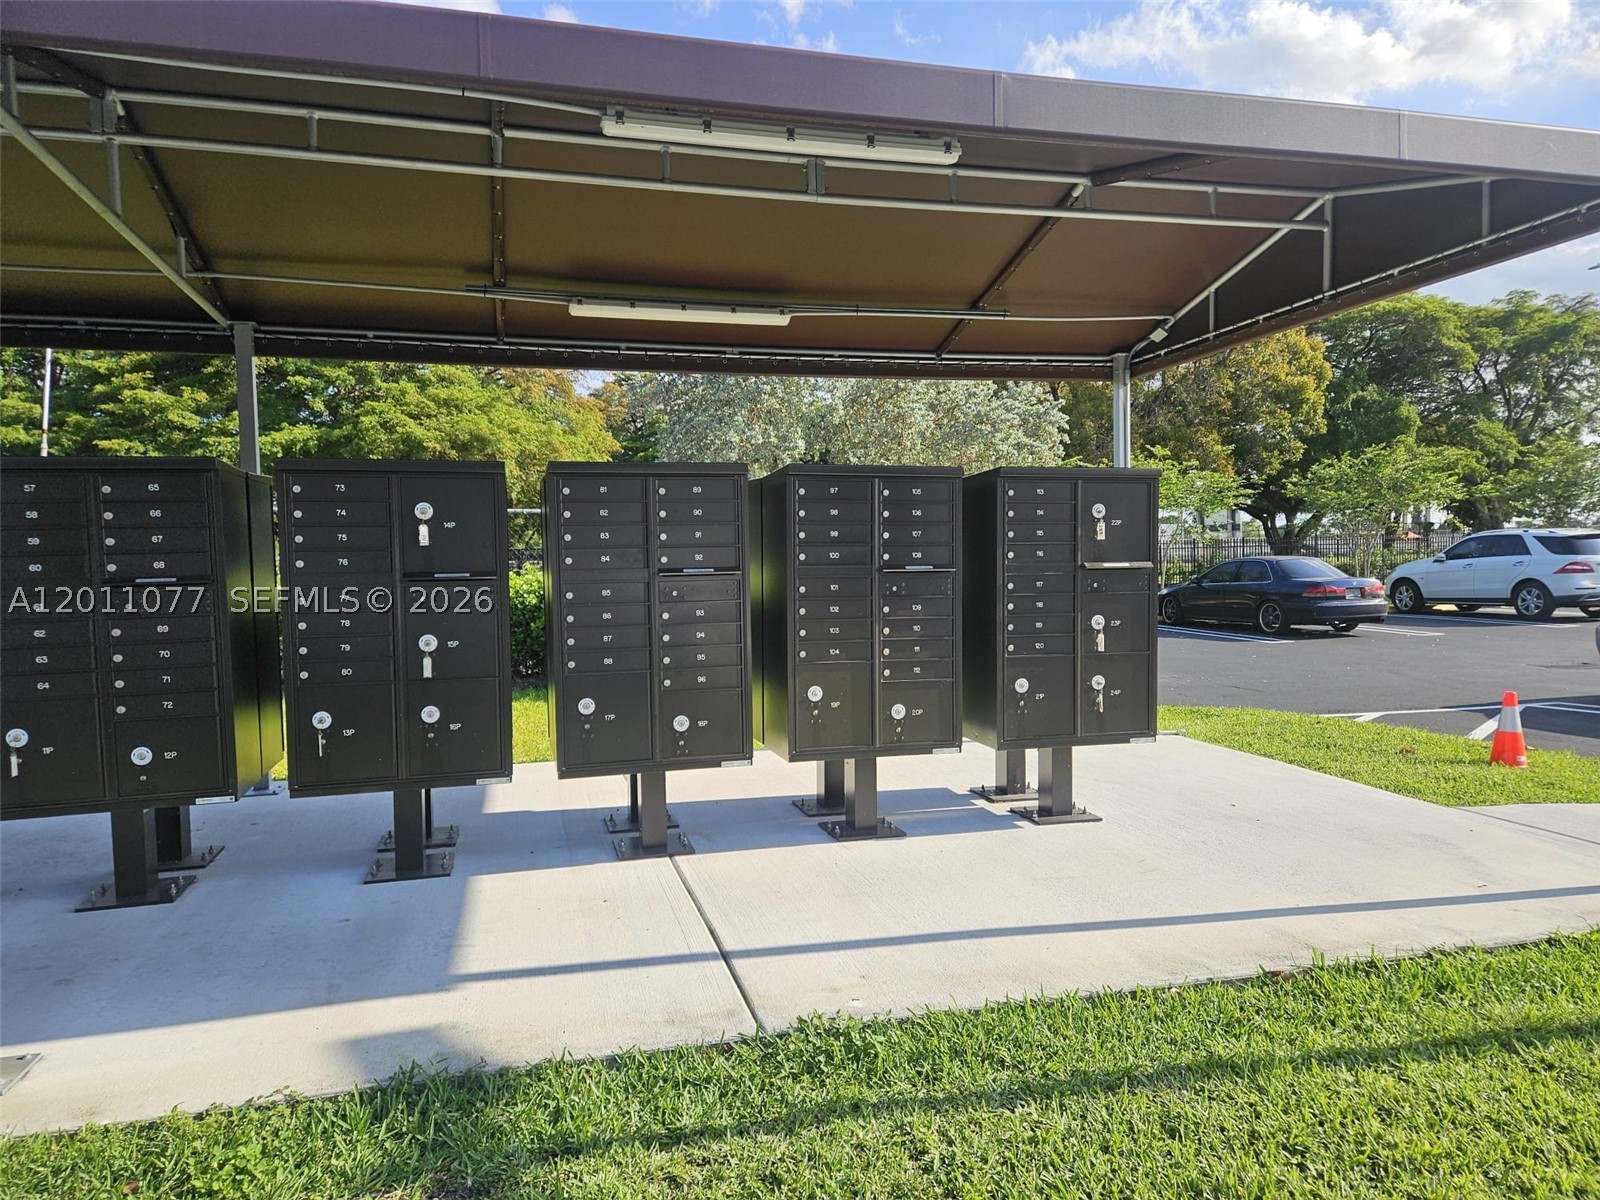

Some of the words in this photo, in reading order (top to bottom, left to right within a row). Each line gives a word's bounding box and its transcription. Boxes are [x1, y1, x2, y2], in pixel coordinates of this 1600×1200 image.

[23, 484, 36, 492] 57
[147, 483, 160, 492] 65
[334, 484, 346, 492] 73
[692, 486, 702, 494] 89
[25, 510, 39, 519] 58
[149, 509, 162, 518] 66
[335, 509, 347, 517] 74
[599, 509, 609, 517] 82
[692, 508, 703, 516] 90
[911, 509, 922, 517] 106
[443, 521, 456, 529] 14P
[336, 533, 348, 542] 75
[599, 532, 610, 540] 83
[694, 531, 702, 539] 91
[829, 530, 839, 538] 99
[911, 530, 922, 538] 107
[27, 537, 40, 546] 59
[151, 535, 163, 543] 67
[600, 555, 611, 563] 84
[694, 553, 704, 561] 92
[829, 551, 840, 559] 100
[911, 551, 922, 559] 108
[152, 561, 166, 569] 68
[337, 558, 349, 566] 76
[28, 563, 43, 572] 60
[601, 589, 612, 597] 85
[695, 609, 705, 617] 93
[829, 605, 840, 613] 102
[340, 619, 351, 627] 78
[156, 625, 169, 633] 69
[912, 624, 921, 632] 110
[33, 629, 47, 638] 62
[695, 631, 706, 639] 94
[603, 635, 613, 643] 87
[339, 643, 351, 652] 79
[158, 650, 171, 658] 70
[829, 648, 840, 656] 104
[35, 655, 49, 664] 63
[603, 657, 614, 665] 88
[696, 653, 706, 661] 95
[341, 668, 353, 676] 80
[161, 675, 171, 684] 71
[697, 675, 707, 683] 96
[36, 682, 50, 690] 64
[162, 701, 174, 709] 72
[911, 708, 924, 716] 20P
[604, 713, 616, 721] 17P
[342, 728, 356, 737] 13P
[163, 751, 178, 760] 12P
